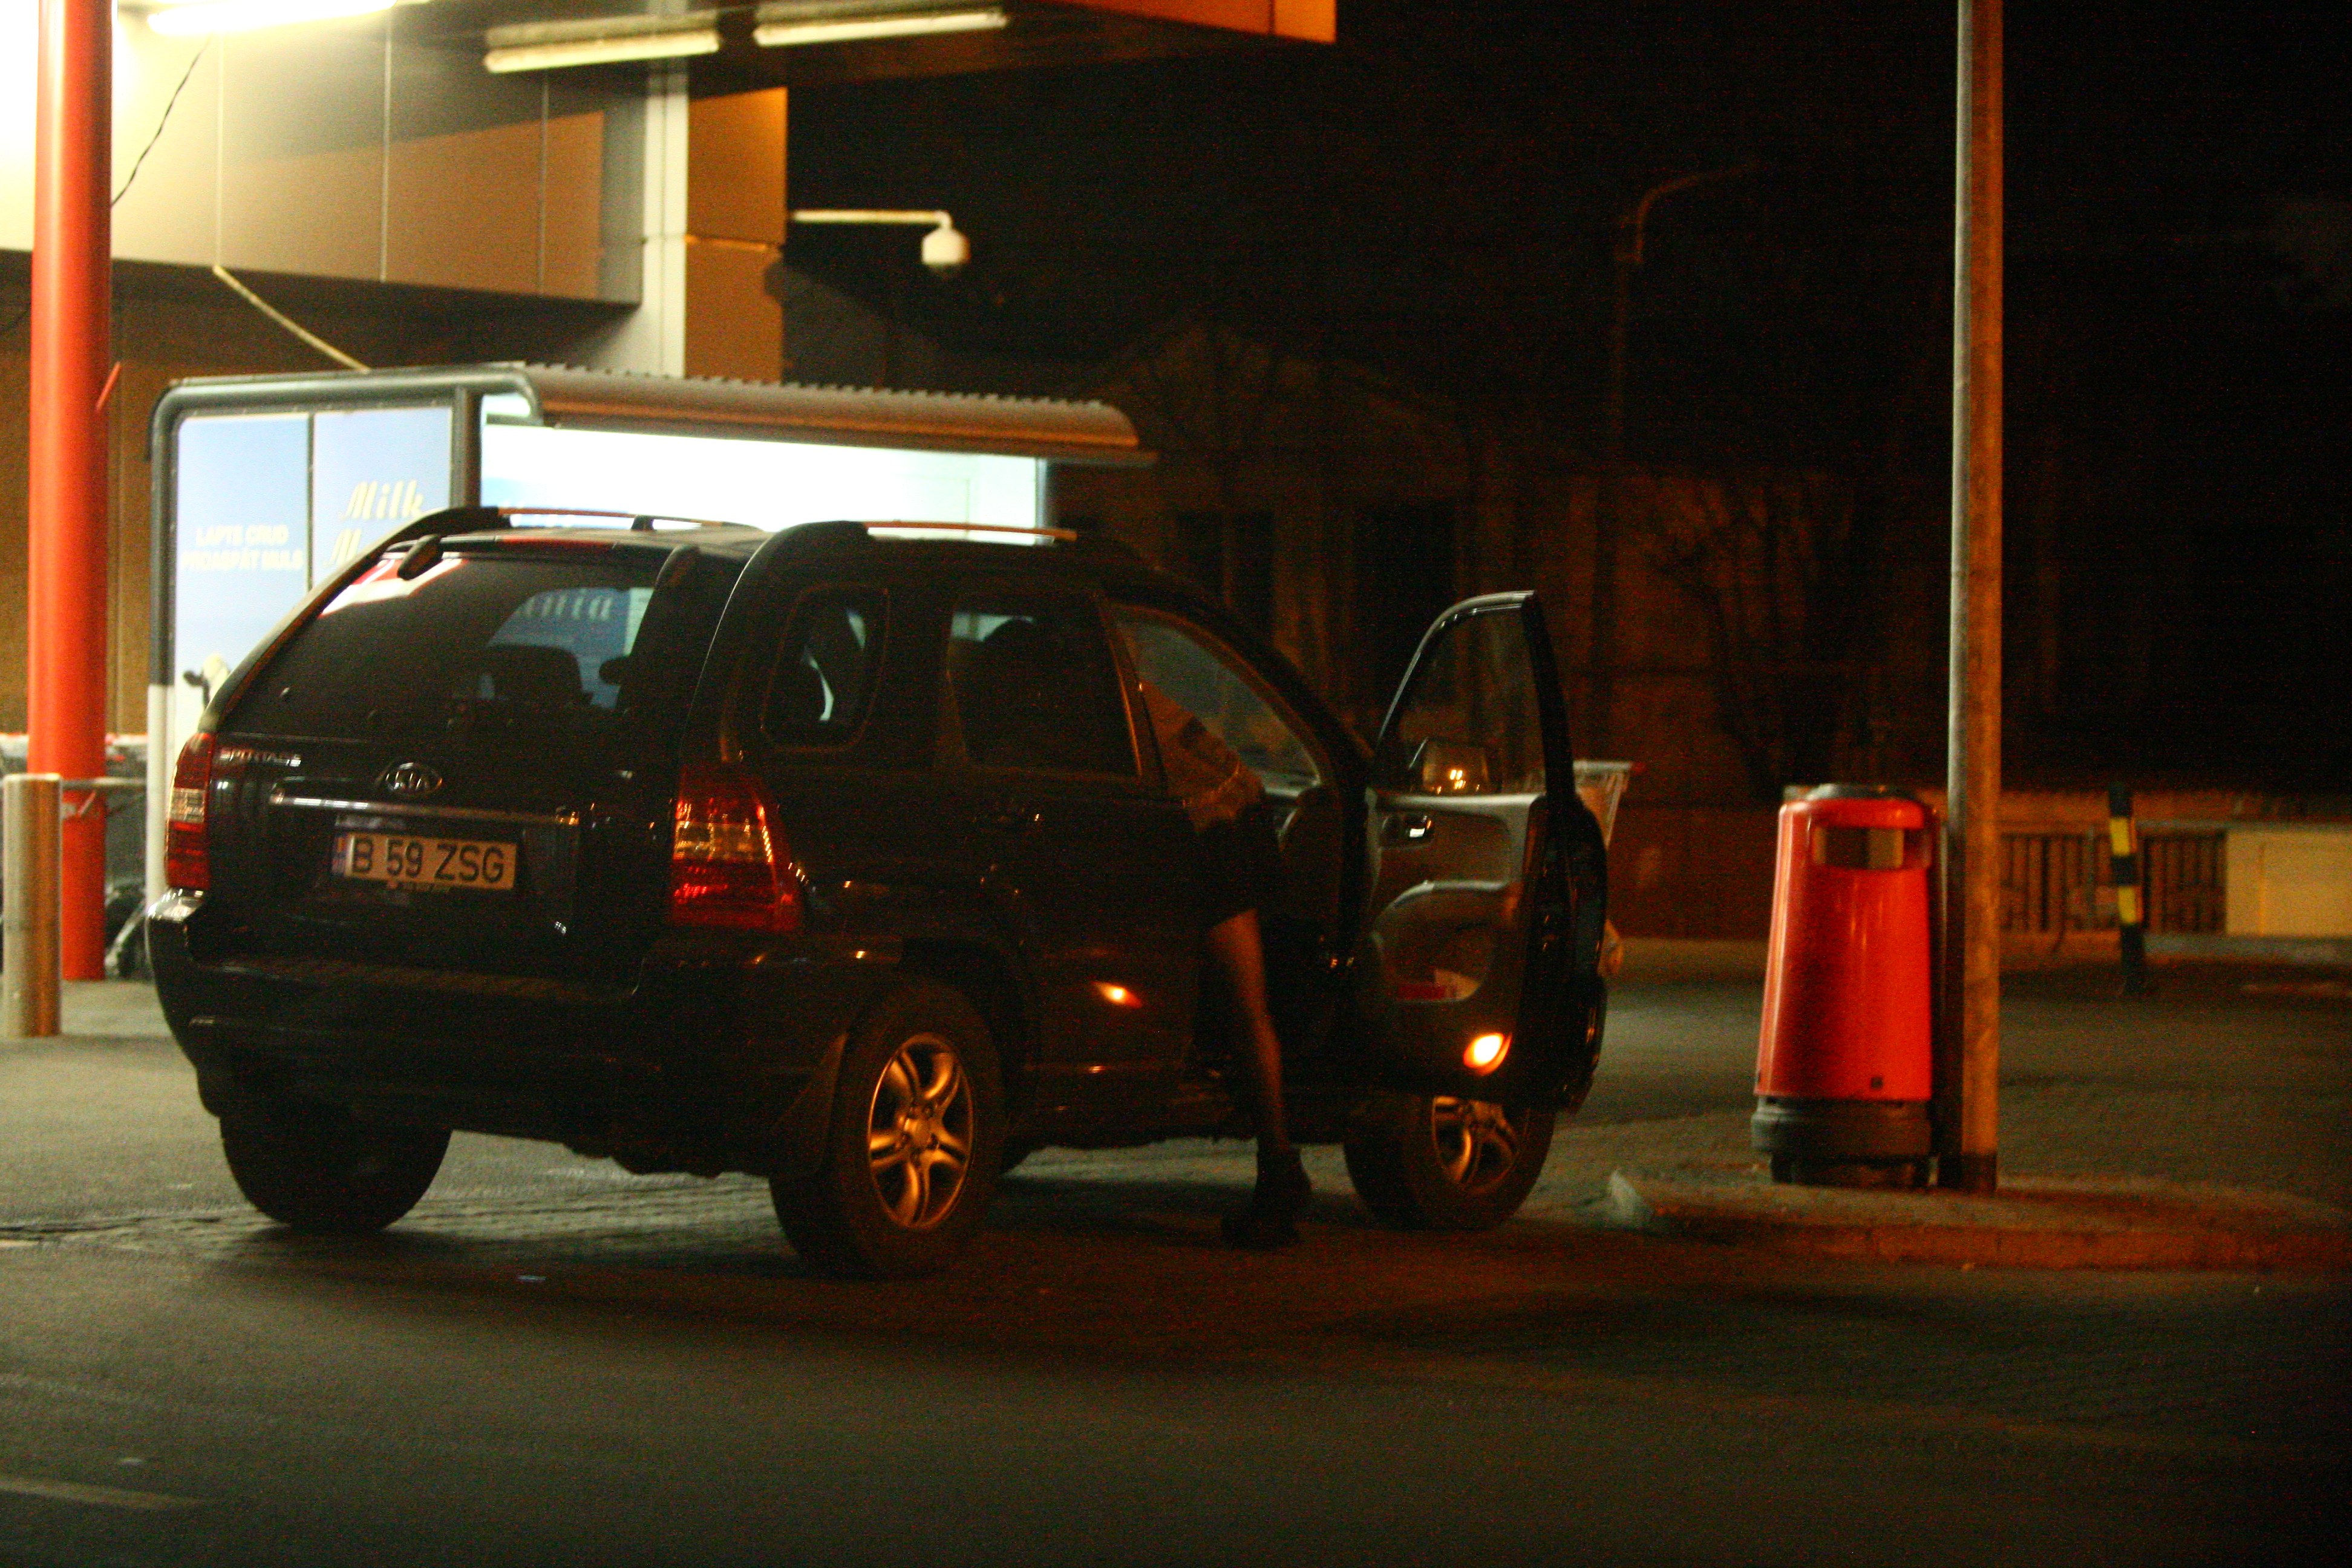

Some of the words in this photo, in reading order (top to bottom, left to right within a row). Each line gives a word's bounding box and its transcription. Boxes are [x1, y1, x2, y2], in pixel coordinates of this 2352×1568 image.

[339, 480, 425, 520] Milk
[352, 838, 373, 873] B
[385, 838, 423, 877] 59
[434, 843, 505, 883] ZSG
